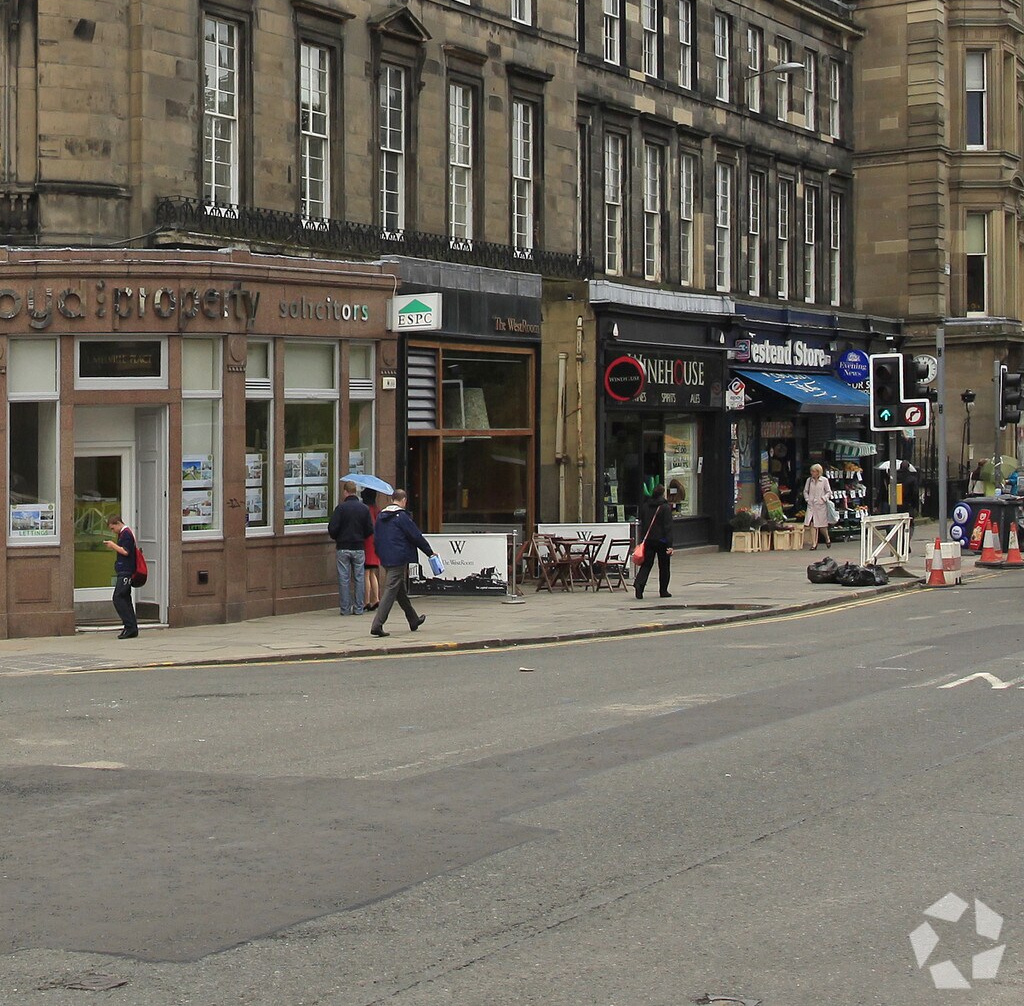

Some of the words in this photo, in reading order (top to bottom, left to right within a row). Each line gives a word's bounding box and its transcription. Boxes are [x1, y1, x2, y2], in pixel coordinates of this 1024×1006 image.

[112, 280, 260, 331] property
[279, 296, 369, 322] solicitors
[398, 313, 432, 326] ESPC
[749, 332, 792, 366] estend
[793, 340, 825, 367] Store
[839, 361, 867, 371] Evening
[844, 369, 862, 377] News
[661, 393, 676, 403] SPIRITS
[690, 394, 701, 404] ALES
[449, 540, 466, 554] W
